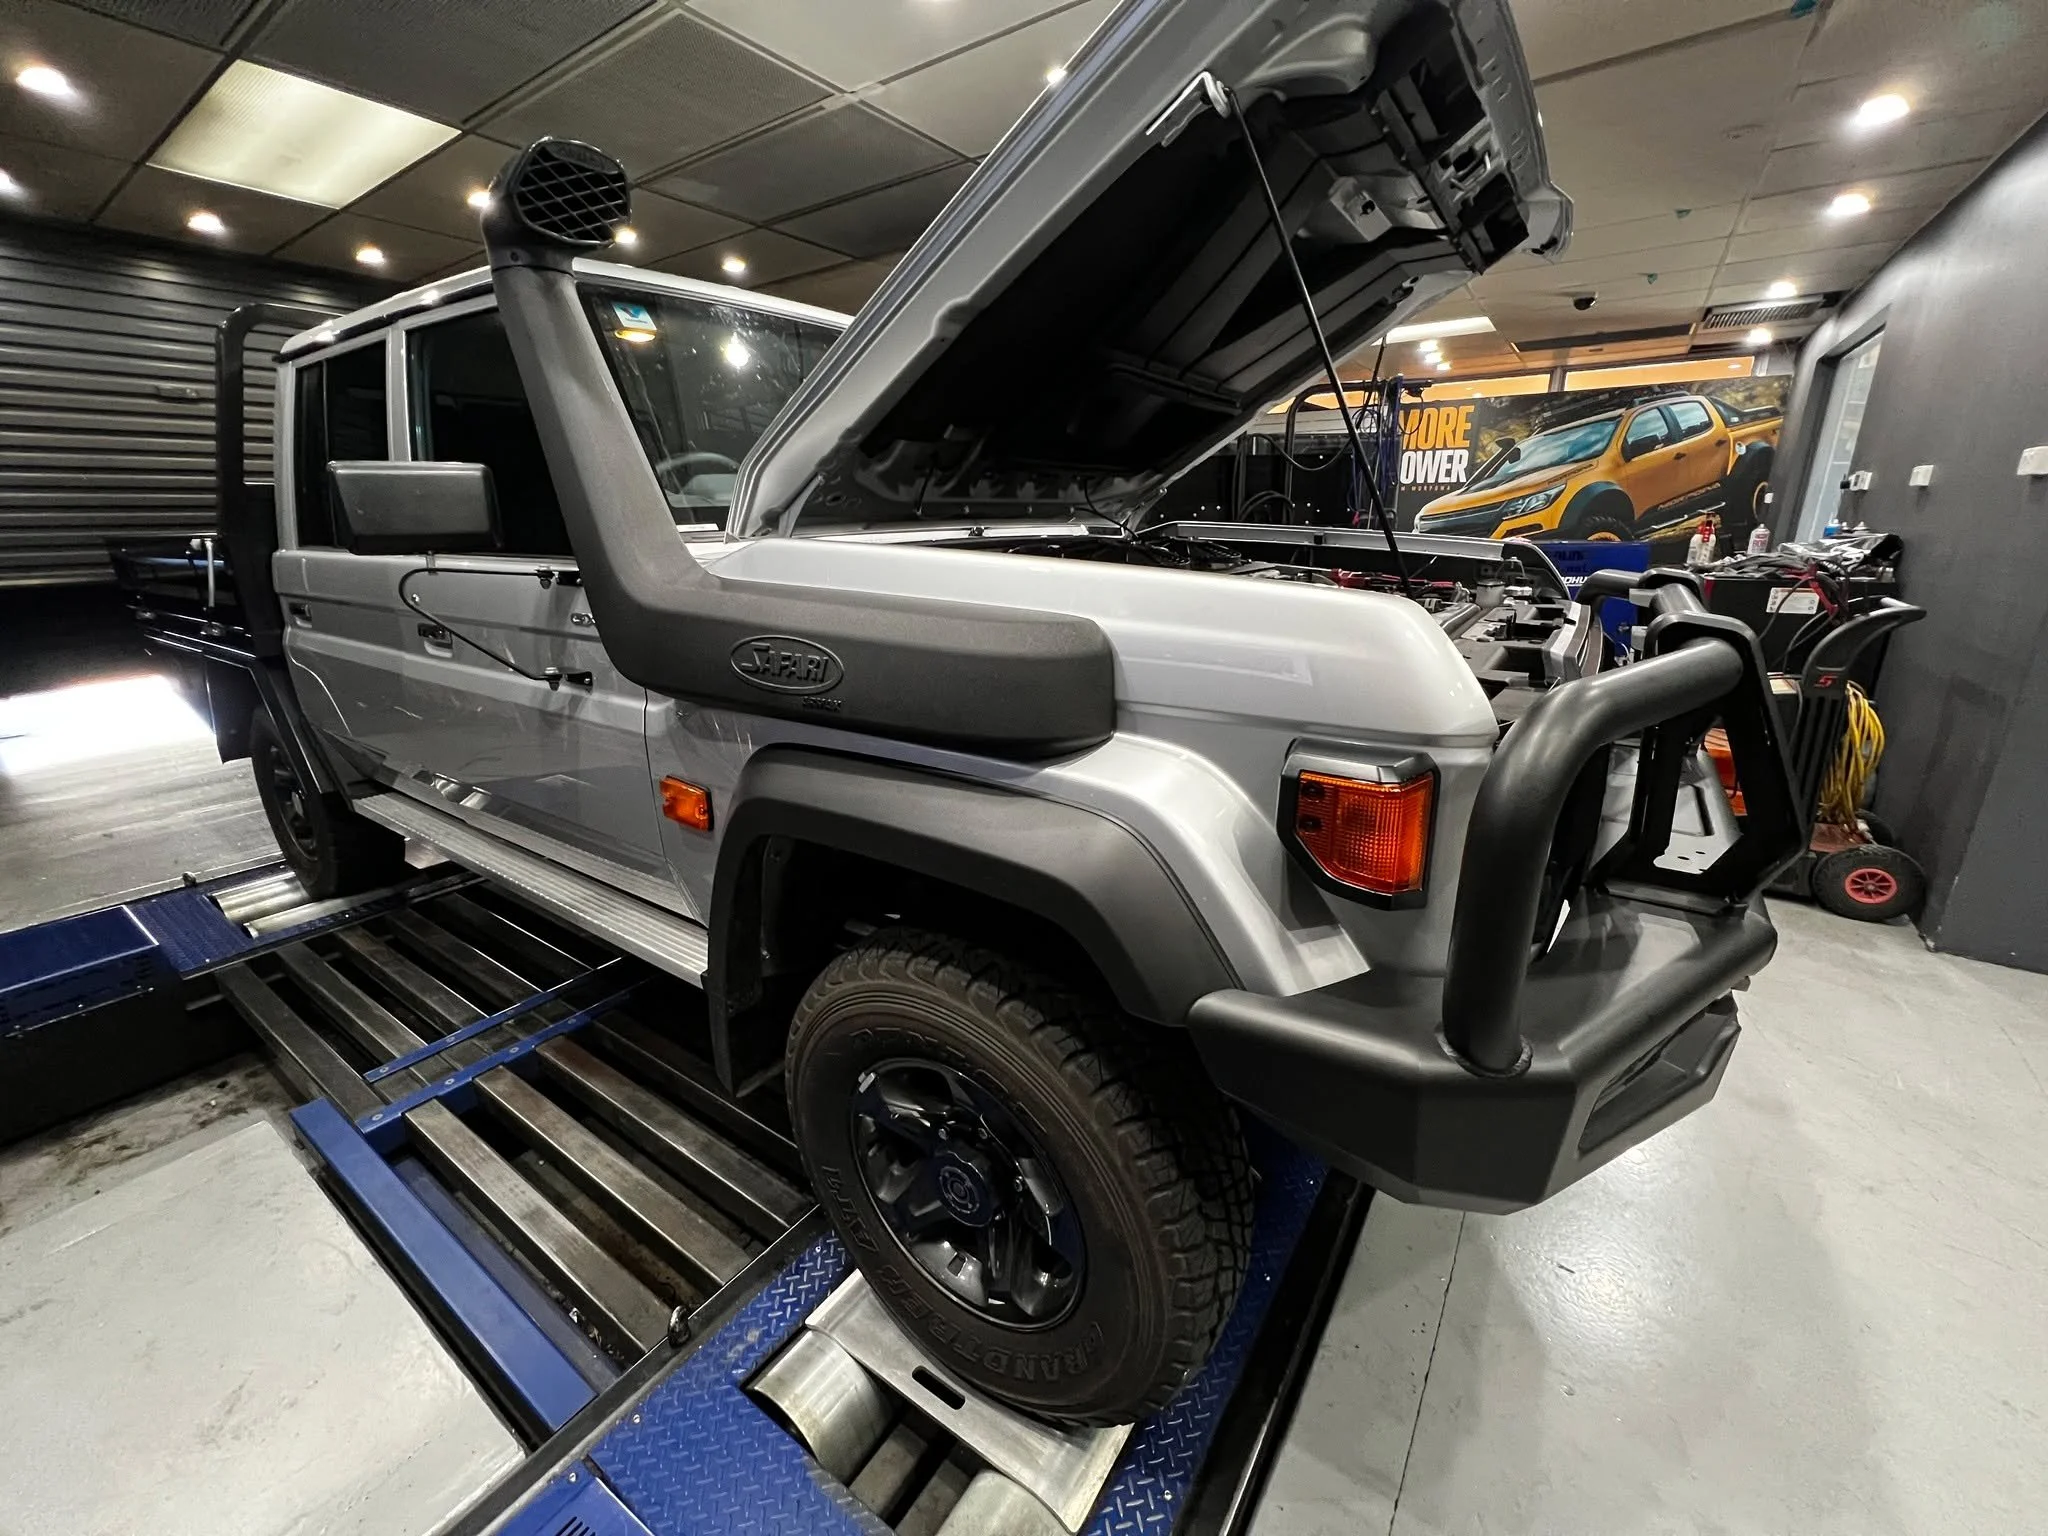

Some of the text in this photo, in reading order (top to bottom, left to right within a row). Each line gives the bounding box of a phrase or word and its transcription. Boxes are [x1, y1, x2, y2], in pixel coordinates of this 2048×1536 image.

[1399, 405, 1474, 450] MORE
[1400, 449, 1469, 485] OWER
[740, 641, 830, 683] SAFARI
